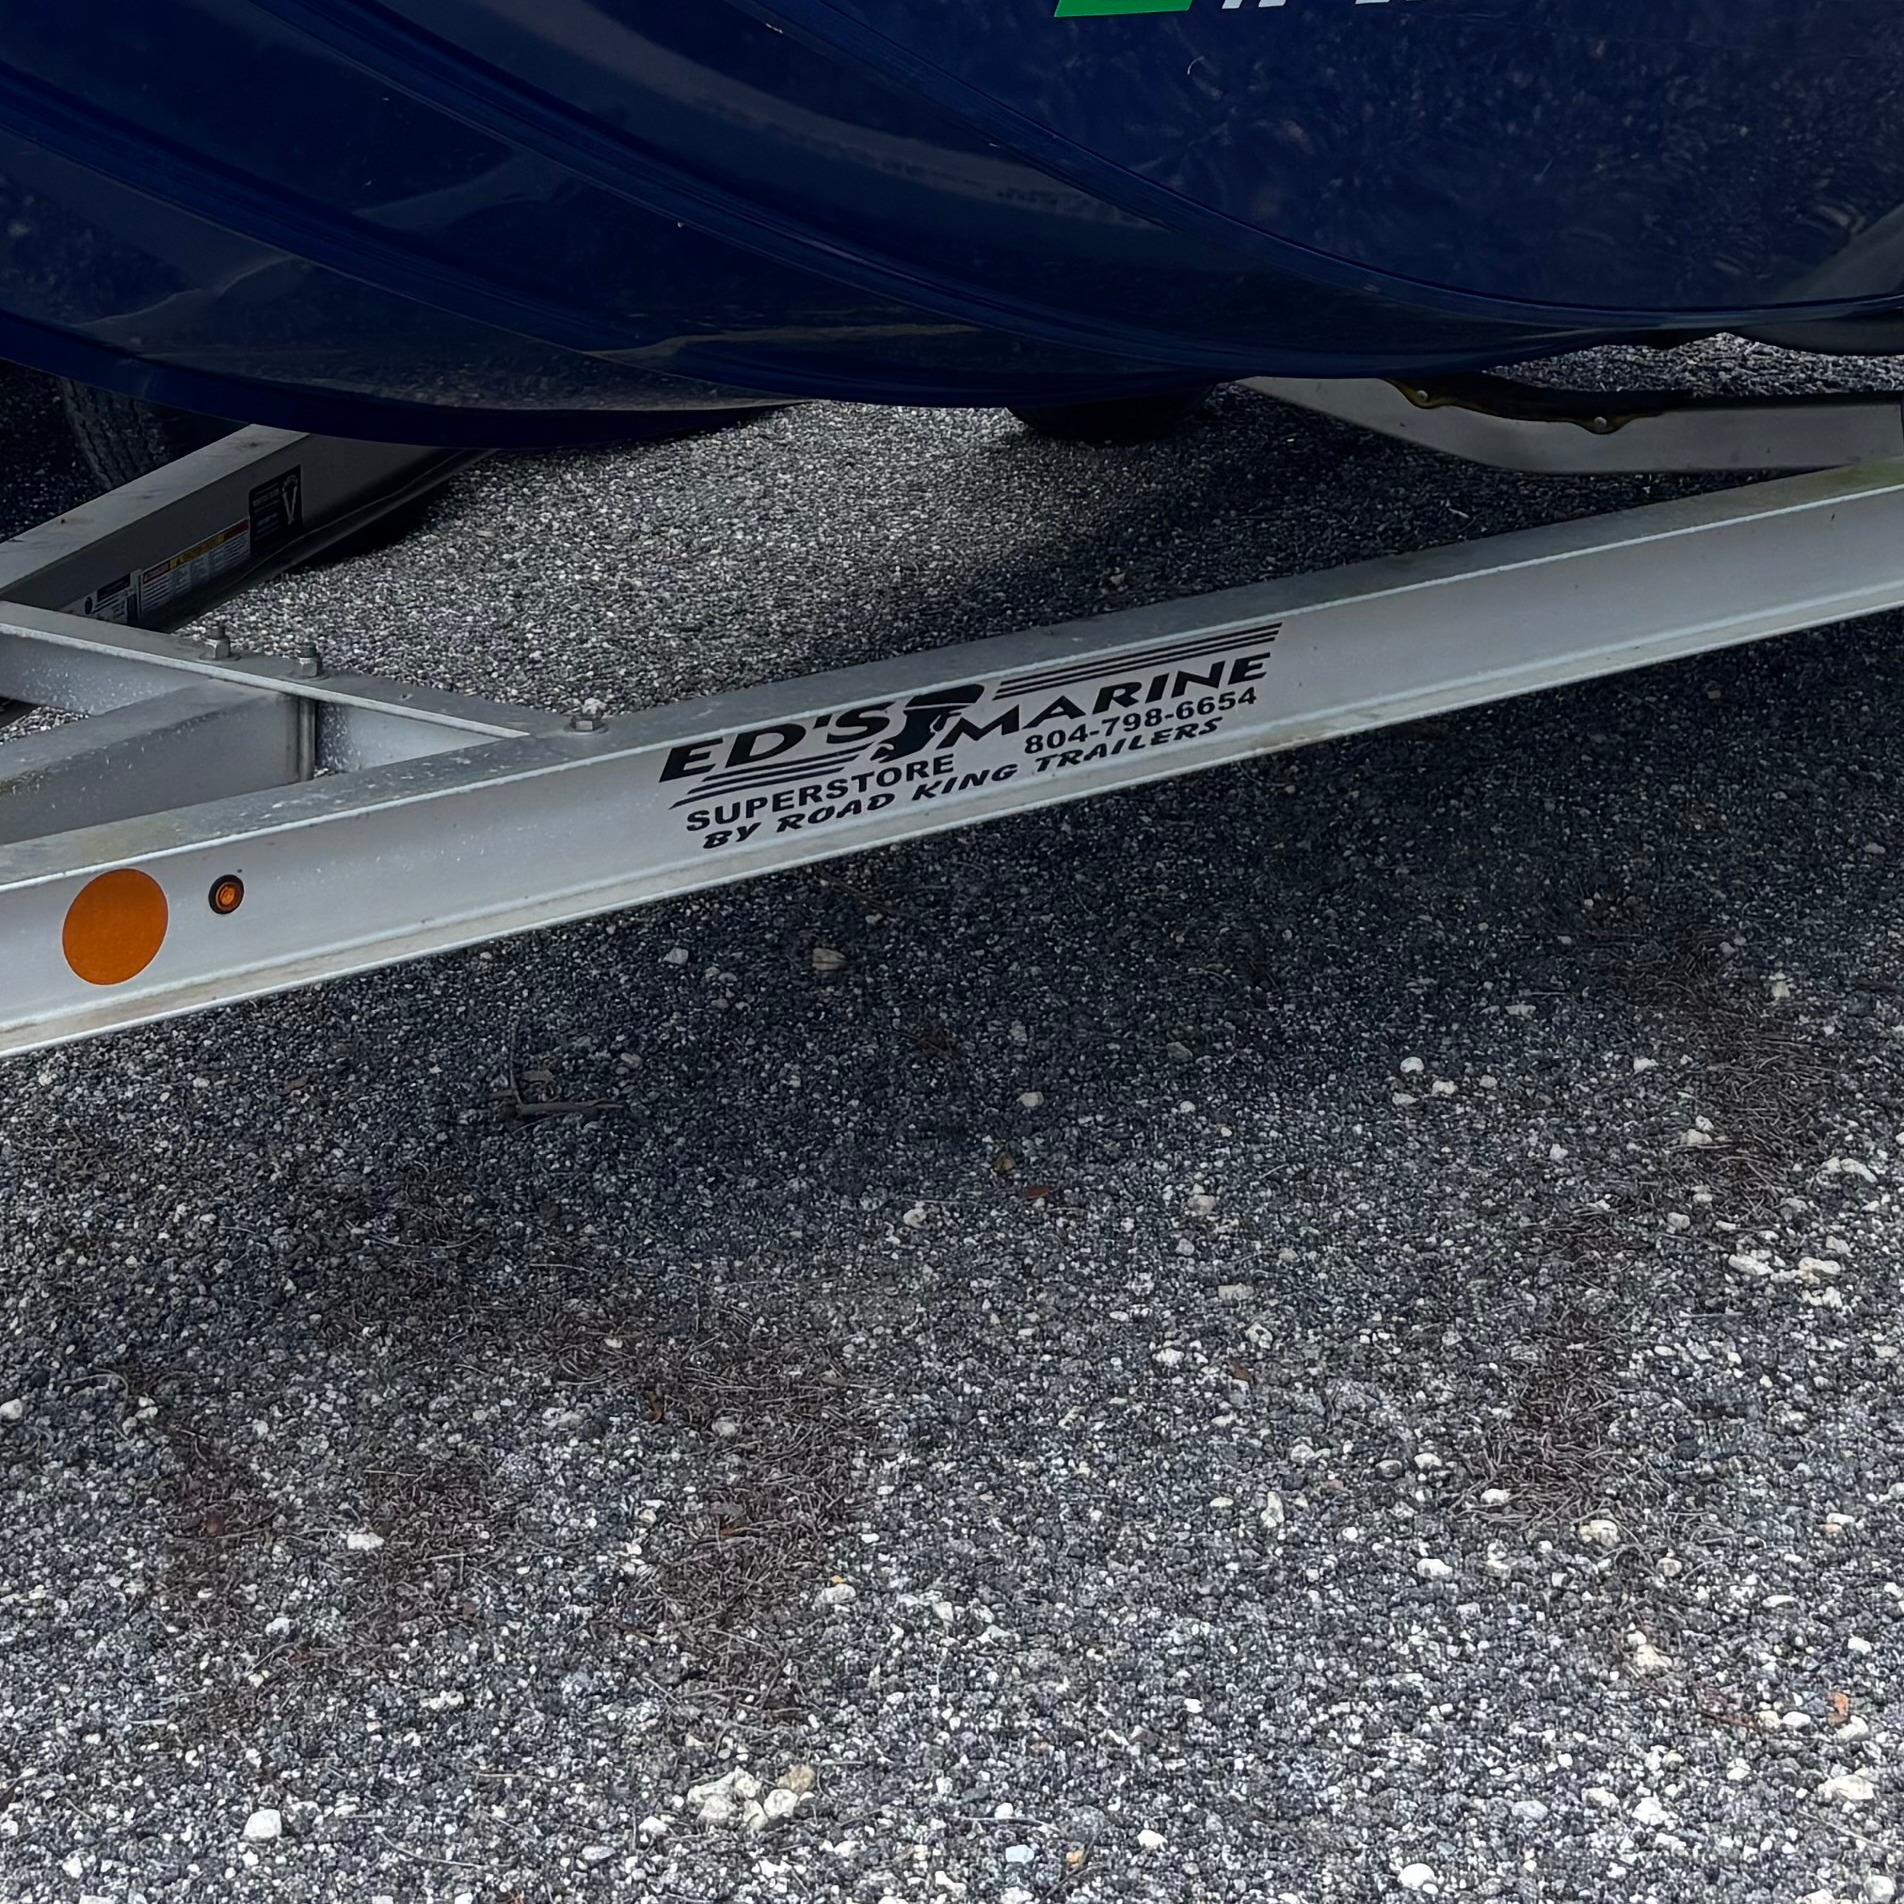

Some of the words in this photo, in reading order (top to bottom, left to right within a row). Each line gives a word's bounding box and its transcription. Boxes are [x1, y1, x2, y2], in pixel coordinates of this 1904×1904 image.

[659, 701, 895, 783] ED'S
[936, 652, 1271, 750] MARINE
[1024, 686, 1257, 755] 804-798-6654
[686, 753, 954, 832] SUPERSTORE
[702, 822, 762, 850] BY
[776, 793, 896, 833] ROAD
[911, 763, 1019, 802] KING
[1034, 717, 1223, 773] TRAILERS
